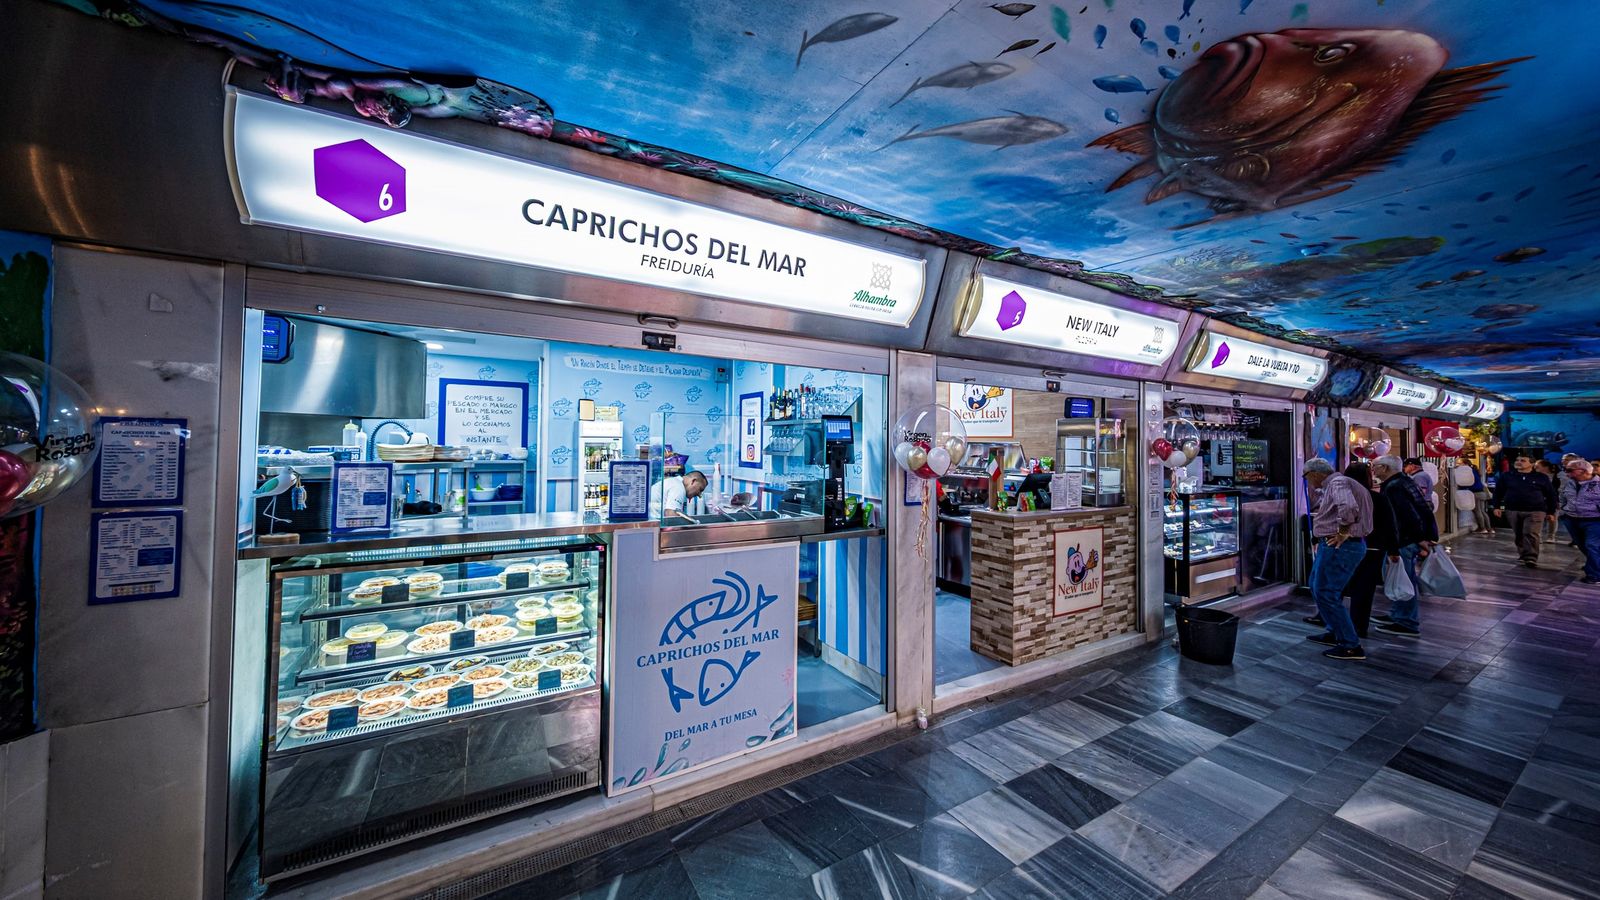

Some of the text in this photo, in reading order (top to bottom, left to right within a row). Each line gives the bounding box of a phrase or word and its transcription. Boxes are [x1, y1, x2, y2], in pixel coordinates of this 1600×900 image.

[379, 183, 393, 211] 6
[521, 198, 807, 278] CAPRICHOS DEL MAR
[640, 253, 716, 279] FREIDURÍA
[852, 289, 897, 307] Alhambra
[1012, 310, 1022, 325] 5
[1066, 315, 1120, 338] NEW ITALY
[1247, 355, 1263, 367] DALE
[1262, 358, 1270, 368] LA
[1270, 360, 1288, 372] VUELTA
[954, 406, 1008, 423] New Italy
[30, 433, 91, 450] Virgen
[466, 435, 502, 443] INSTANTE
[1058, 583, 1077, 596] New
[1080, 577, 1099, 593] Italy
[636, 629, 780, 668] CAPRICHOS DEL MAR
[664, 708, 758, 742] DEL MAR A TU MESA
